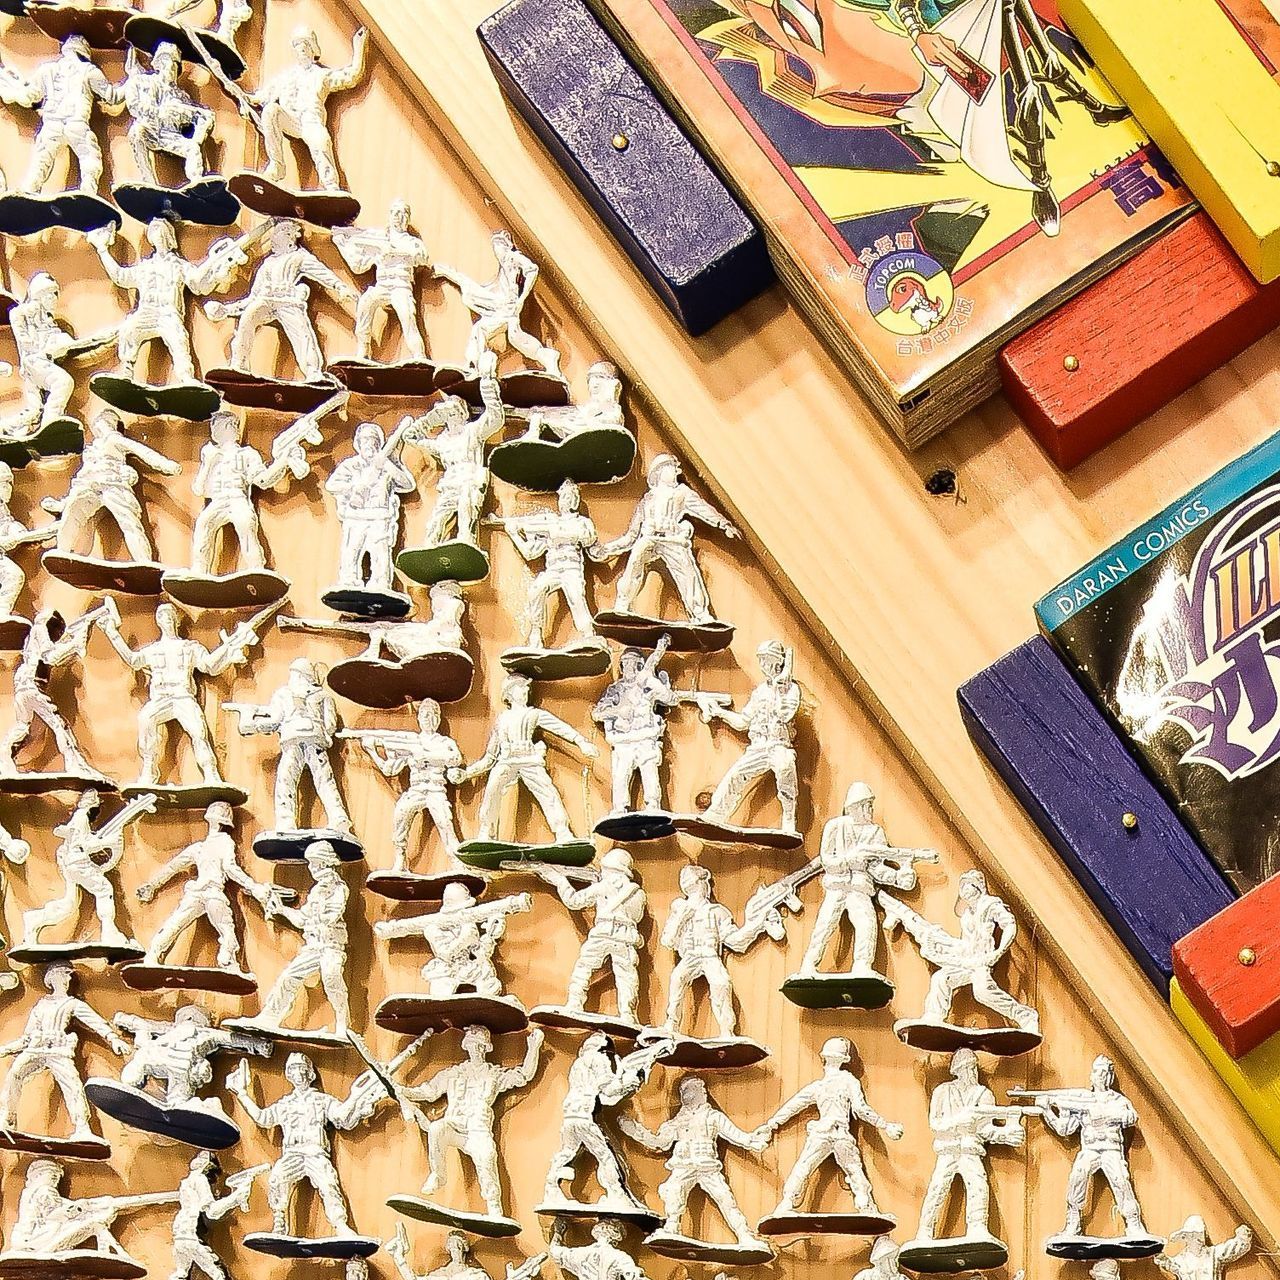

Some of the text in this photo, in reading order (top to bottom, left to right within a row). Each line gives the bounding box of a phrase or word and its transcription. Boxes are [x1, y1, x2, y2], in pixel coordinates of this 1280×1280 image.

[874, 258, 915, 291] TOPCOM
[896, 297, 975, 356] 台灣中文版
[1056, 500, 1210, 616] DARAN COMICS
